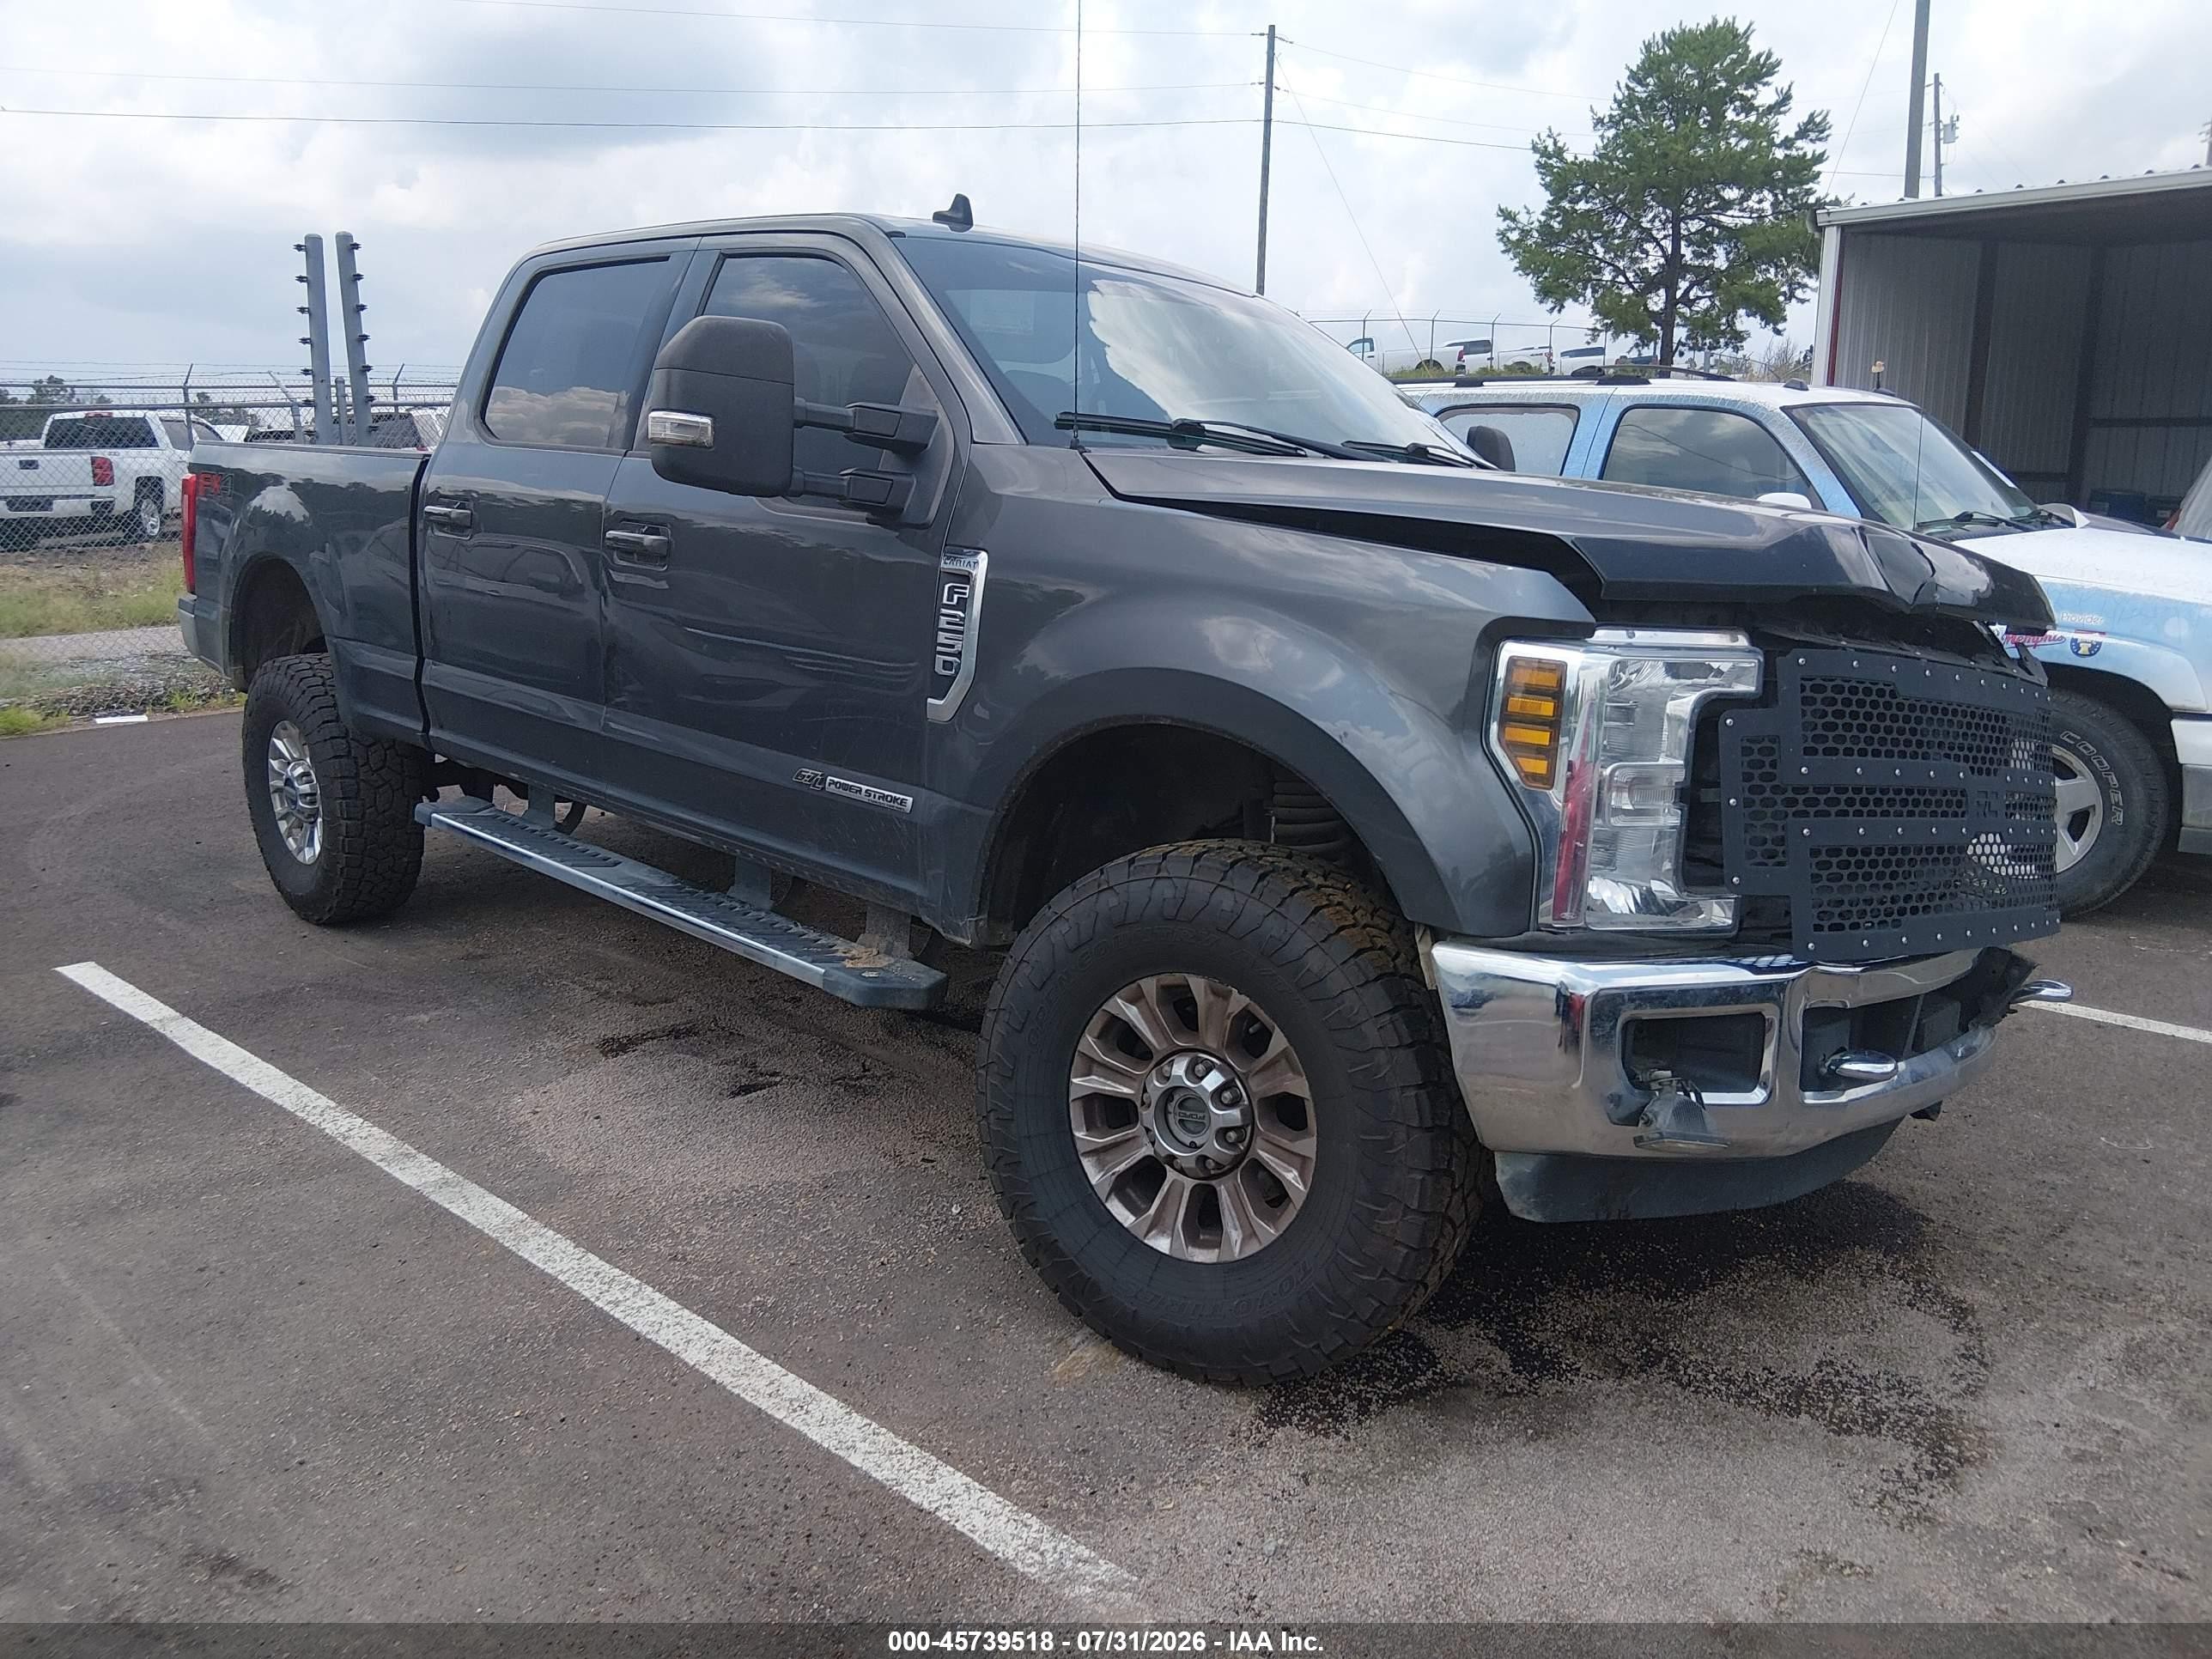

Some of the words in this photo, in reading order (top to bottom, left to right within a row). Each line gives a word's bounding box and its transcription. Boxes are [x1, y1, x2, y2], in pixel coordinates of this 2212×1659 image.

[198, 472, 234, 495] FX4
[2061, 611, 2103, 624] Provider
[2061, 731, 2124, 825] COOPER
[828, 778, 863, 795] POWER
[864, 789, 908, 807] STROKE
